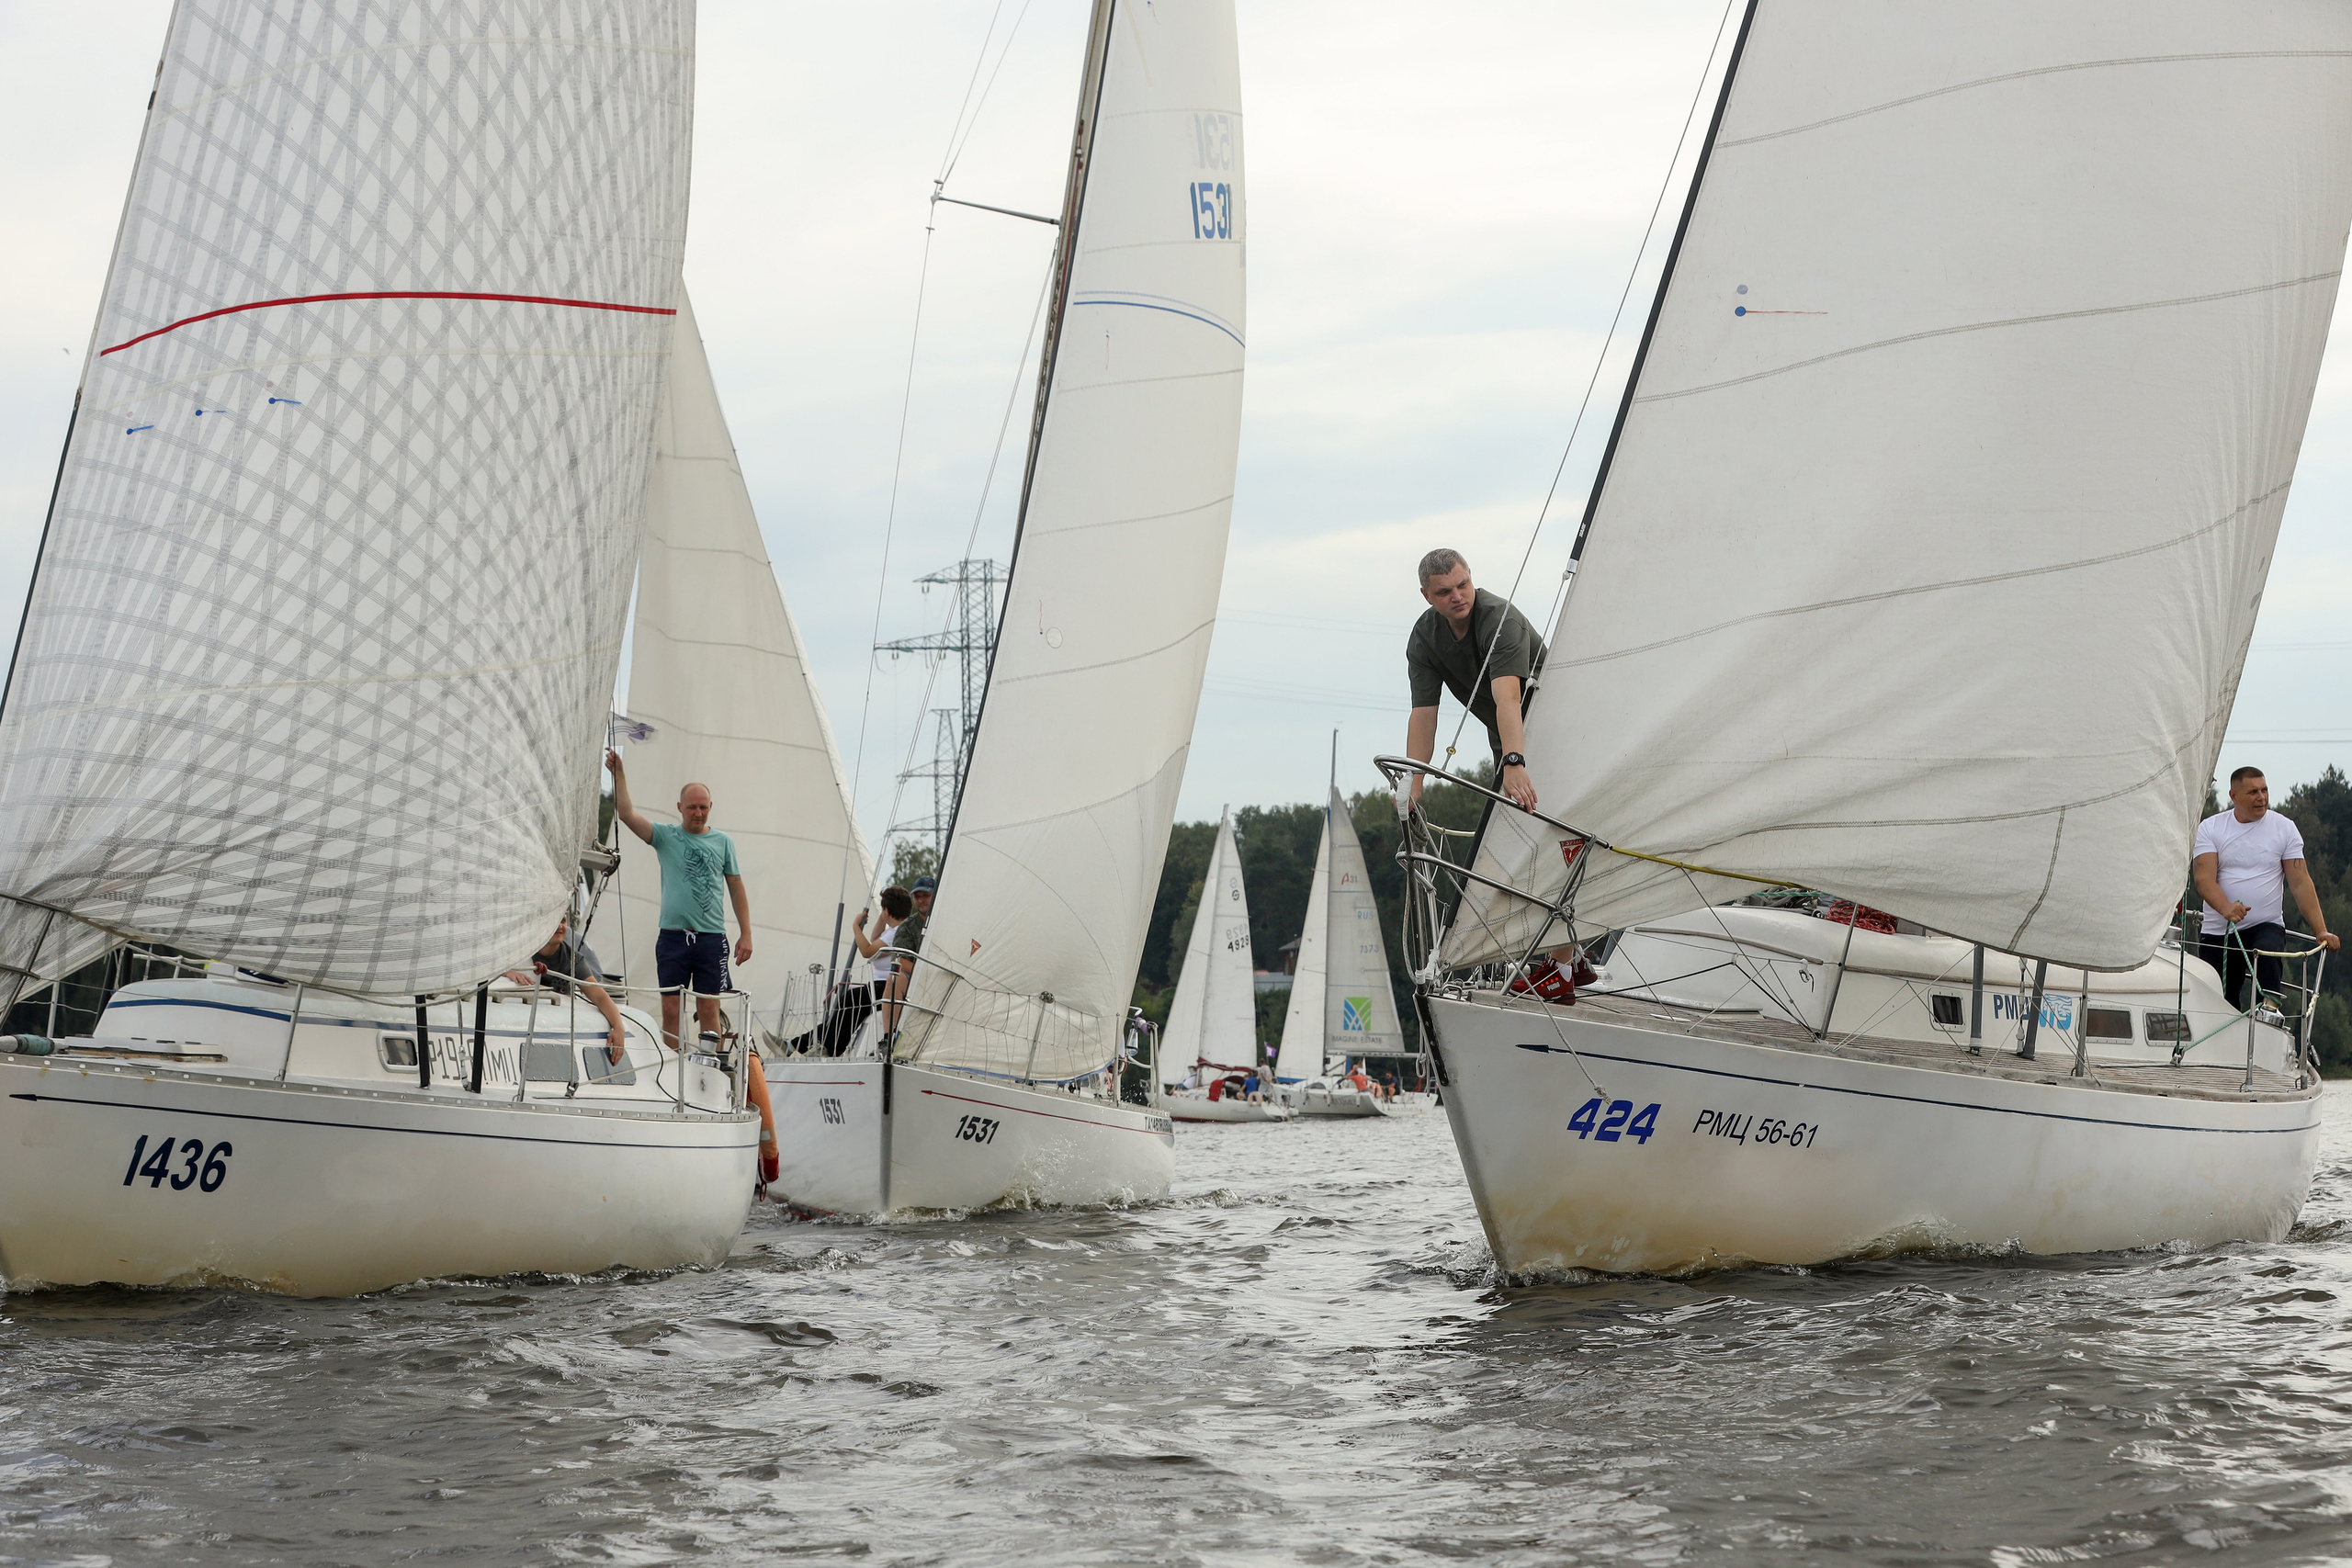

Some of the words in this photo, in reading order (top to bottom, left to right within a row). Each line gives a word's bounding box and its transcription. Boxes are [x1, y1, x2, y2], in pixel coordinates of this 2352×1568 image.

[1190, 182, 1232, 240] 1531
[1227, 934, 1250, 953] 4929
[1361, 1036, 1383, 1044] ESTATE
[819, 1098, 846, 1125] 1531
[1566, 1098, 1662, 1145] 424
[1692, 1109, 1753, 1146] РМЦ
[1755, 1117, 1819, 1149] 56-61
[955, 1114, 1001, 1145] 1531
[122, 1134, 233, 1193] 1436
